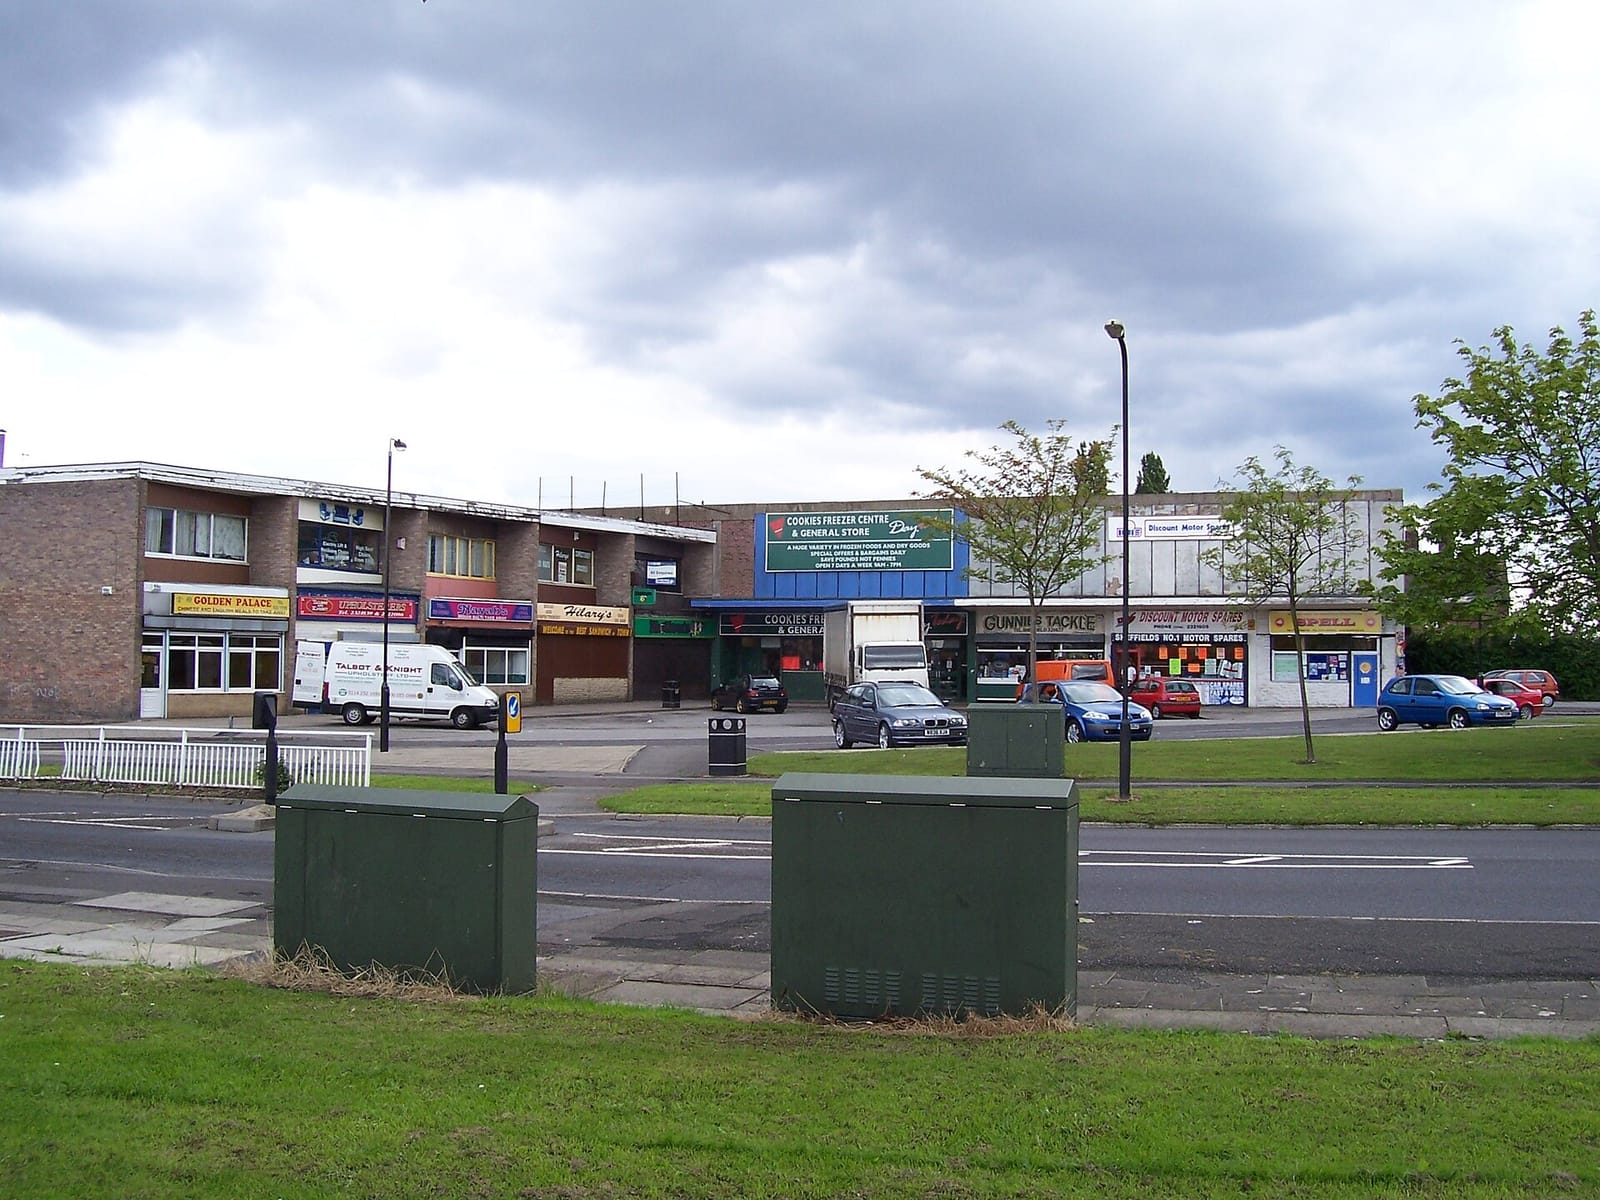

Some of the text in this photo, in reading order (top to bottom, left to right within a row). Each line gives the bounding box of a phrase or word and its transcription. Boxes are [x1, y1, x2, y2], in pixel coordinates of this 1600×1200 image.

[787, 514, 889, 526] COOKIES FREEZER CENTRE
[792, 527, 869, 537] & GENERAL STORE
[1182, 523, 1203, 531] Motor
[194, 596, 272, 607] GOLDEN PALACE
[339, 600, 406, 611] UPHOLSTEERS
[563, 605, 612, 621] Hilary's
[1139, 611, 1243, 623] DISCOUNT MOTOR SPARES
[765, 614, 806, 624] COOKIES
[1045, 614, 1096, 631] TACKLE
[1297, 618, 1355, 627] SPELL
[542, 625, 565, 634] WELCOME
[576, 626, 587, 635] BEST
[588, 626, 612, 636] SANDWICH
[778, 626, 785, 634] &
[335, 662, 371, 671] TALBOT
[386, 665, 423, 673] KNIGHT
